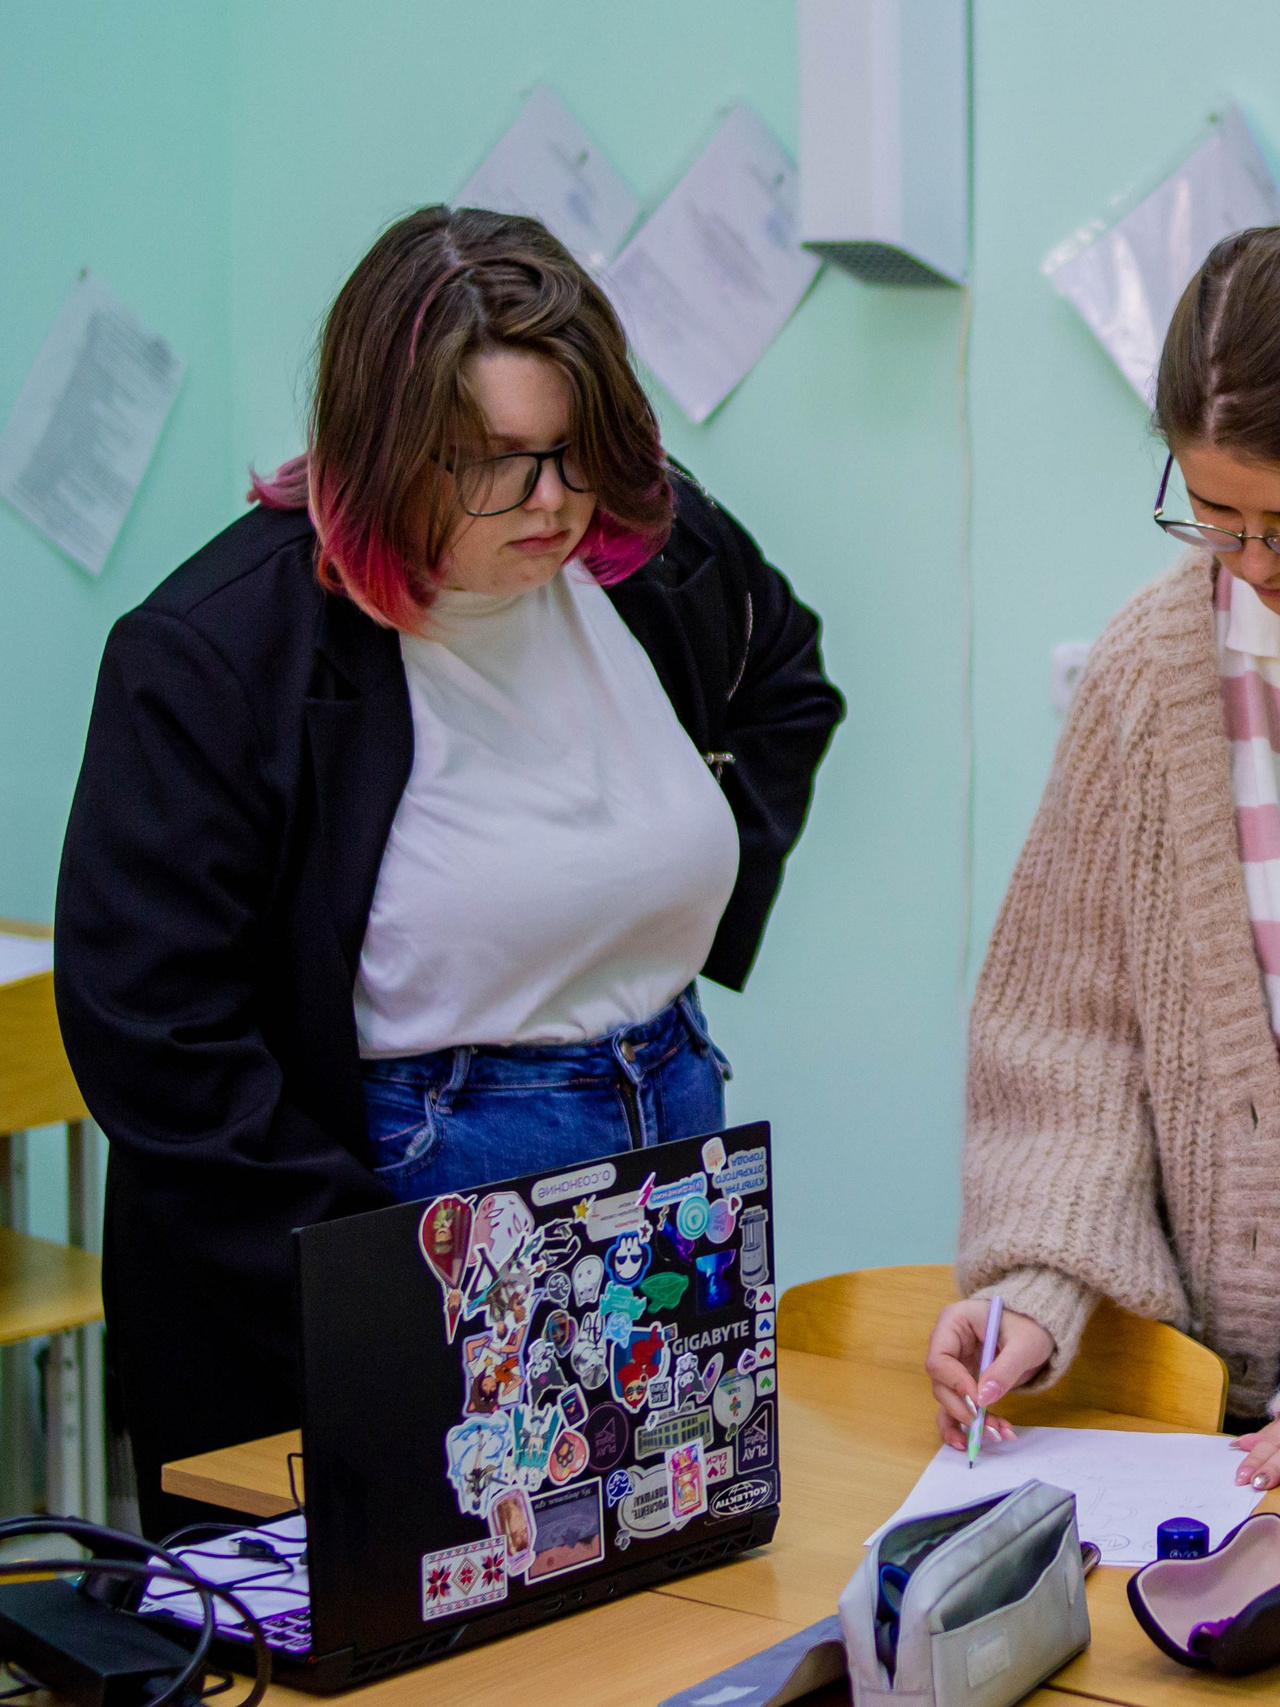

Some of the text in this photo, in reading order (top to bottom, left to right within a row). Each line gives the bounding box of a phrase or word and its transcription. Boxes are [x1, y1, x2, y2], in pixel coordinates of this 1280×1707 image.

[732, 1151, 765, 1167] ГОРОДА
[715, 1163, 765, 1184] ОТКРЫТОГО
[672, 1319, 750, 1356] GIGABYTE
[743, 1432, 768, 1448] Digital
[742, 1444, 769, 1462] PLAY
[715, 1485, 767, 1510] KOLLEKTIV
